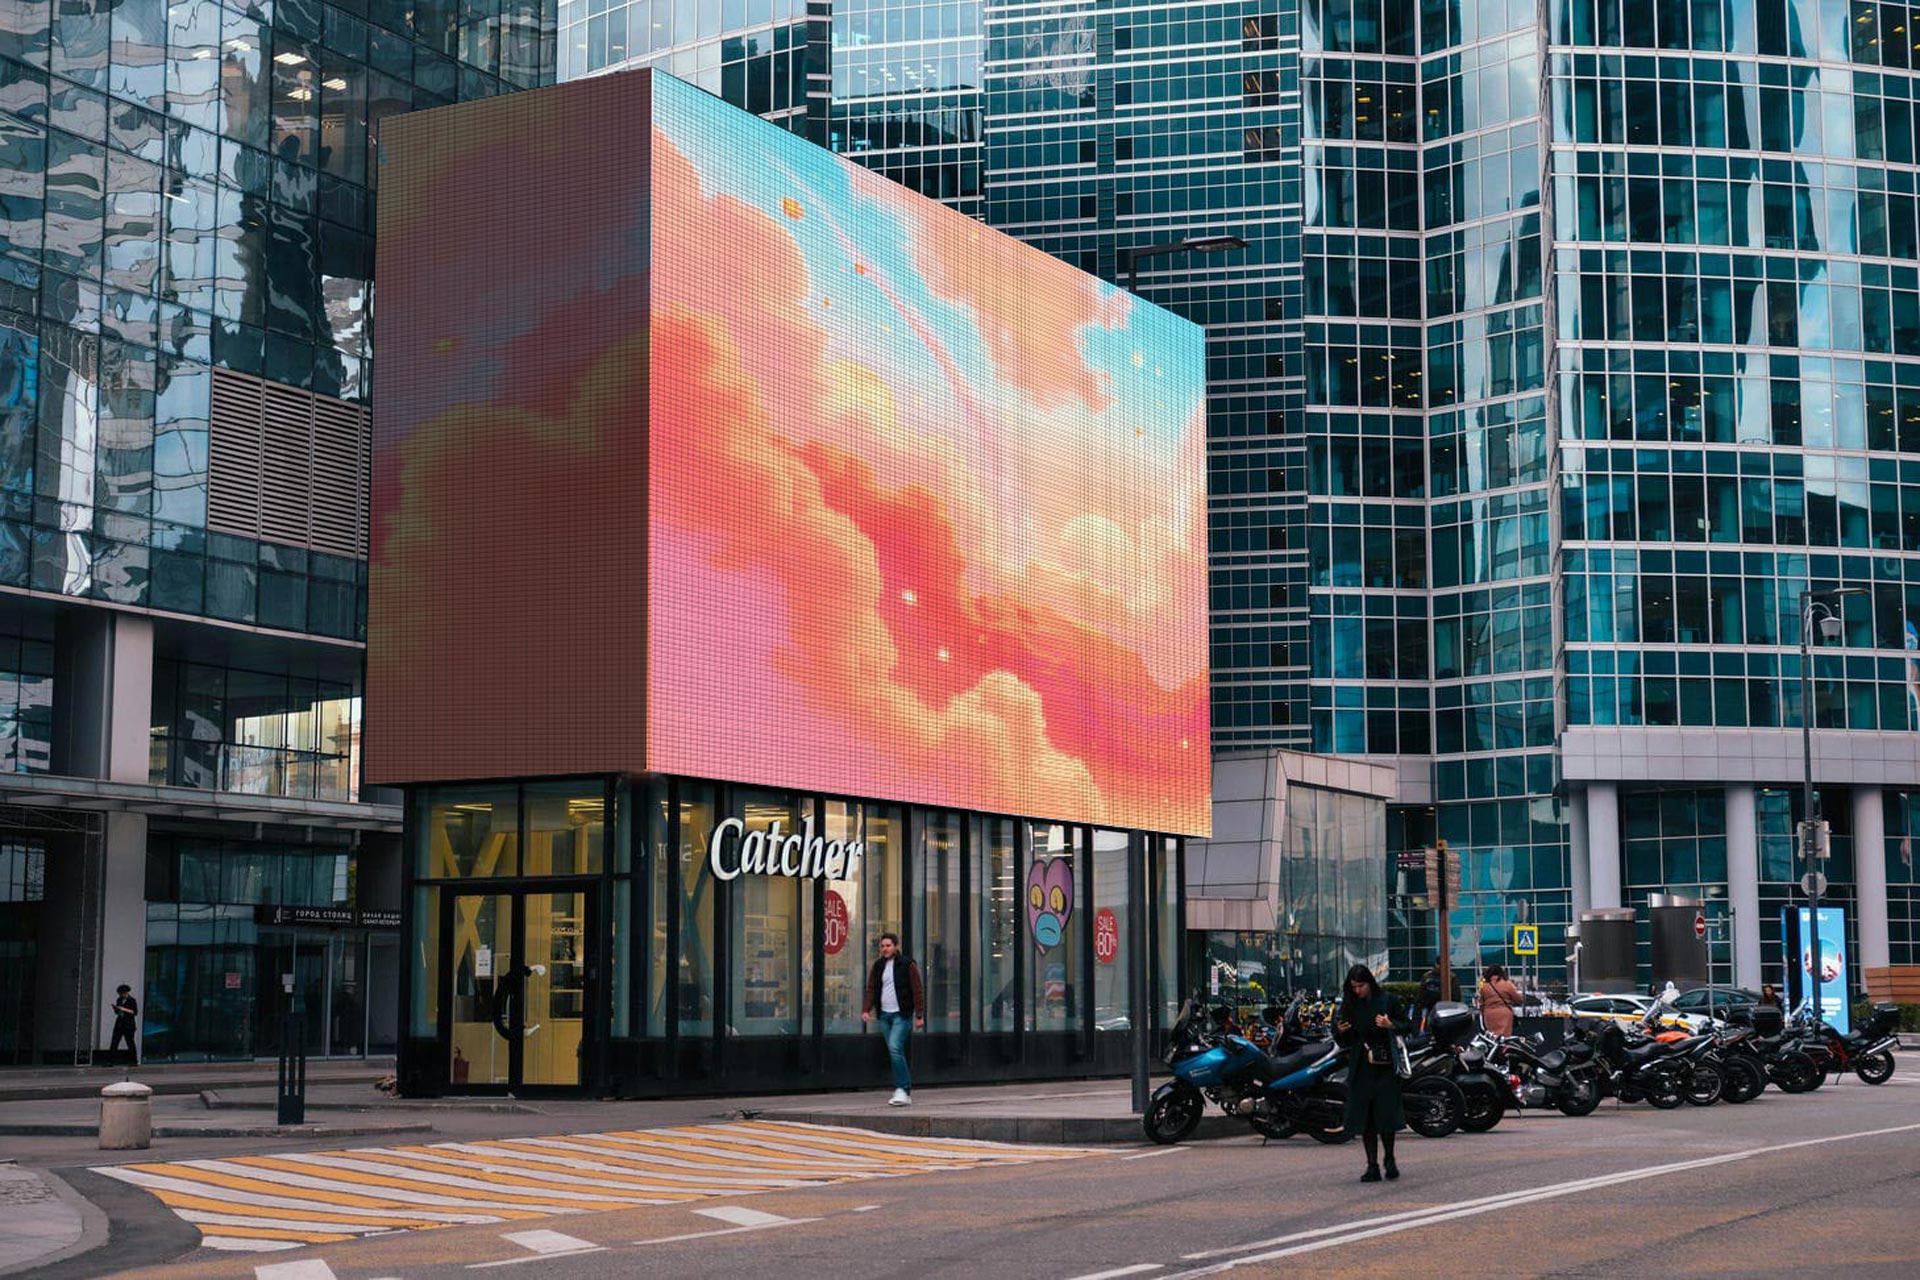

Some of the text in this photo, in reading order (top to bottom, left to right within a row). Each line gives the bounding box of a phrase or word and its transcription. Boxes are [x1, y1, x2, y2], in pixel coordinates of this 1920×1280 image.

[711, 815, 864, 881] Catcher
[295, 910, 320, 918] ГОРОД
[1098, 915, 1114, 931] SALE
